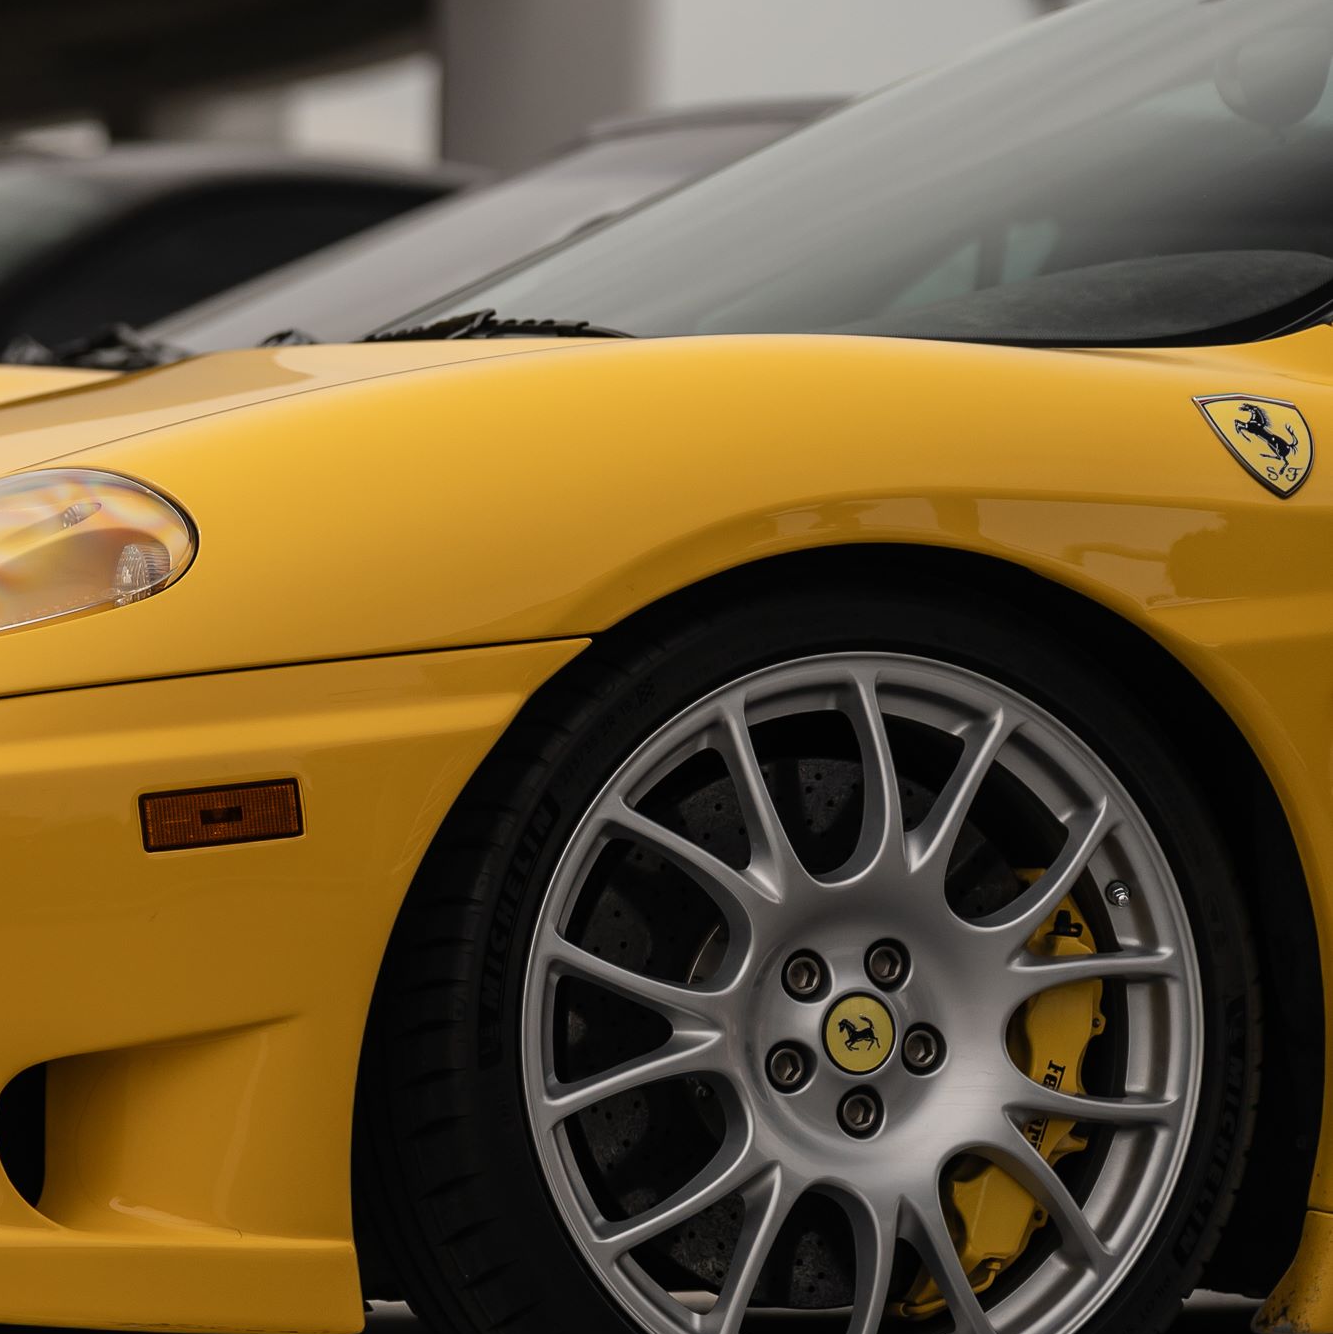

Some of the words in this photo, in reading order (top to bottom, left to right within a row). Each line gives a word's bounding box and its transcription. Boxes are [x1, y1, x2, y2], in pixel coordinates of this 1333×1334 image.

[1266, 466, 1279, 482] S
[1285, 467, 1304, 482] F
[482, 801, 558, 1011] MICHELIN
[1027, 1059, 1066, 1151] Fear
[1177, 1057, 1243, 1255] MICHELIN
